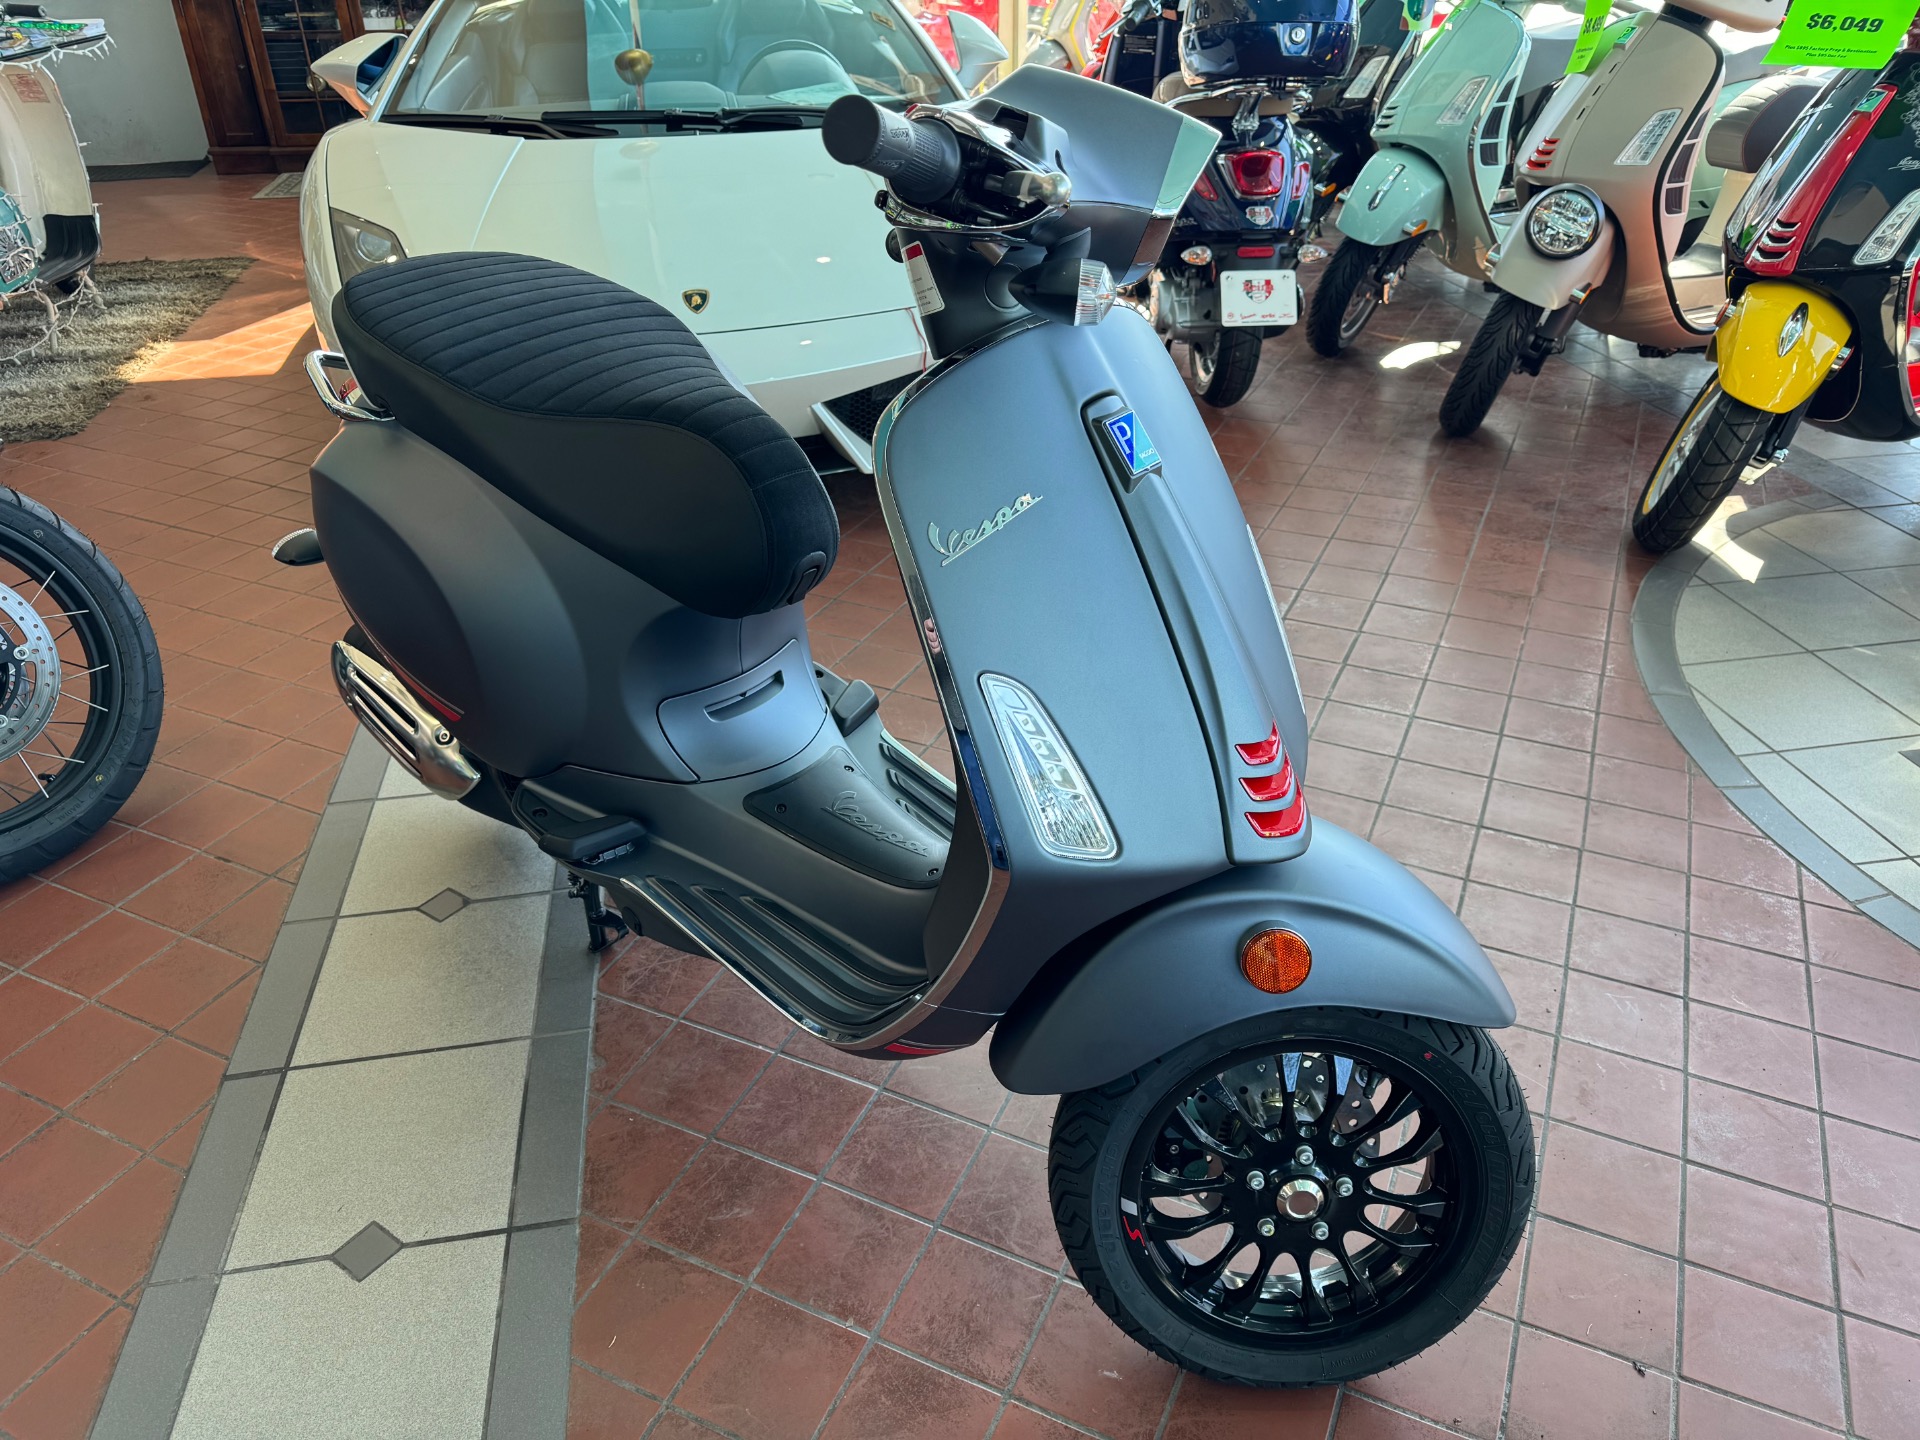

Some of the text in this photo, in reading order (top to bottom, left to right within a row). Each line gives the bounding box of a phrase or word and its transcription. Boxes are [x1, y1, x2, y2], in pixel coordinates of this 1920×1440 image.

[1806, 13, 1884, 33] $6,049
[1111, 421, 1131, 454] P
[928, 493, 1043, 567] Vespa
[820, 790, 928, 857] Vespa
